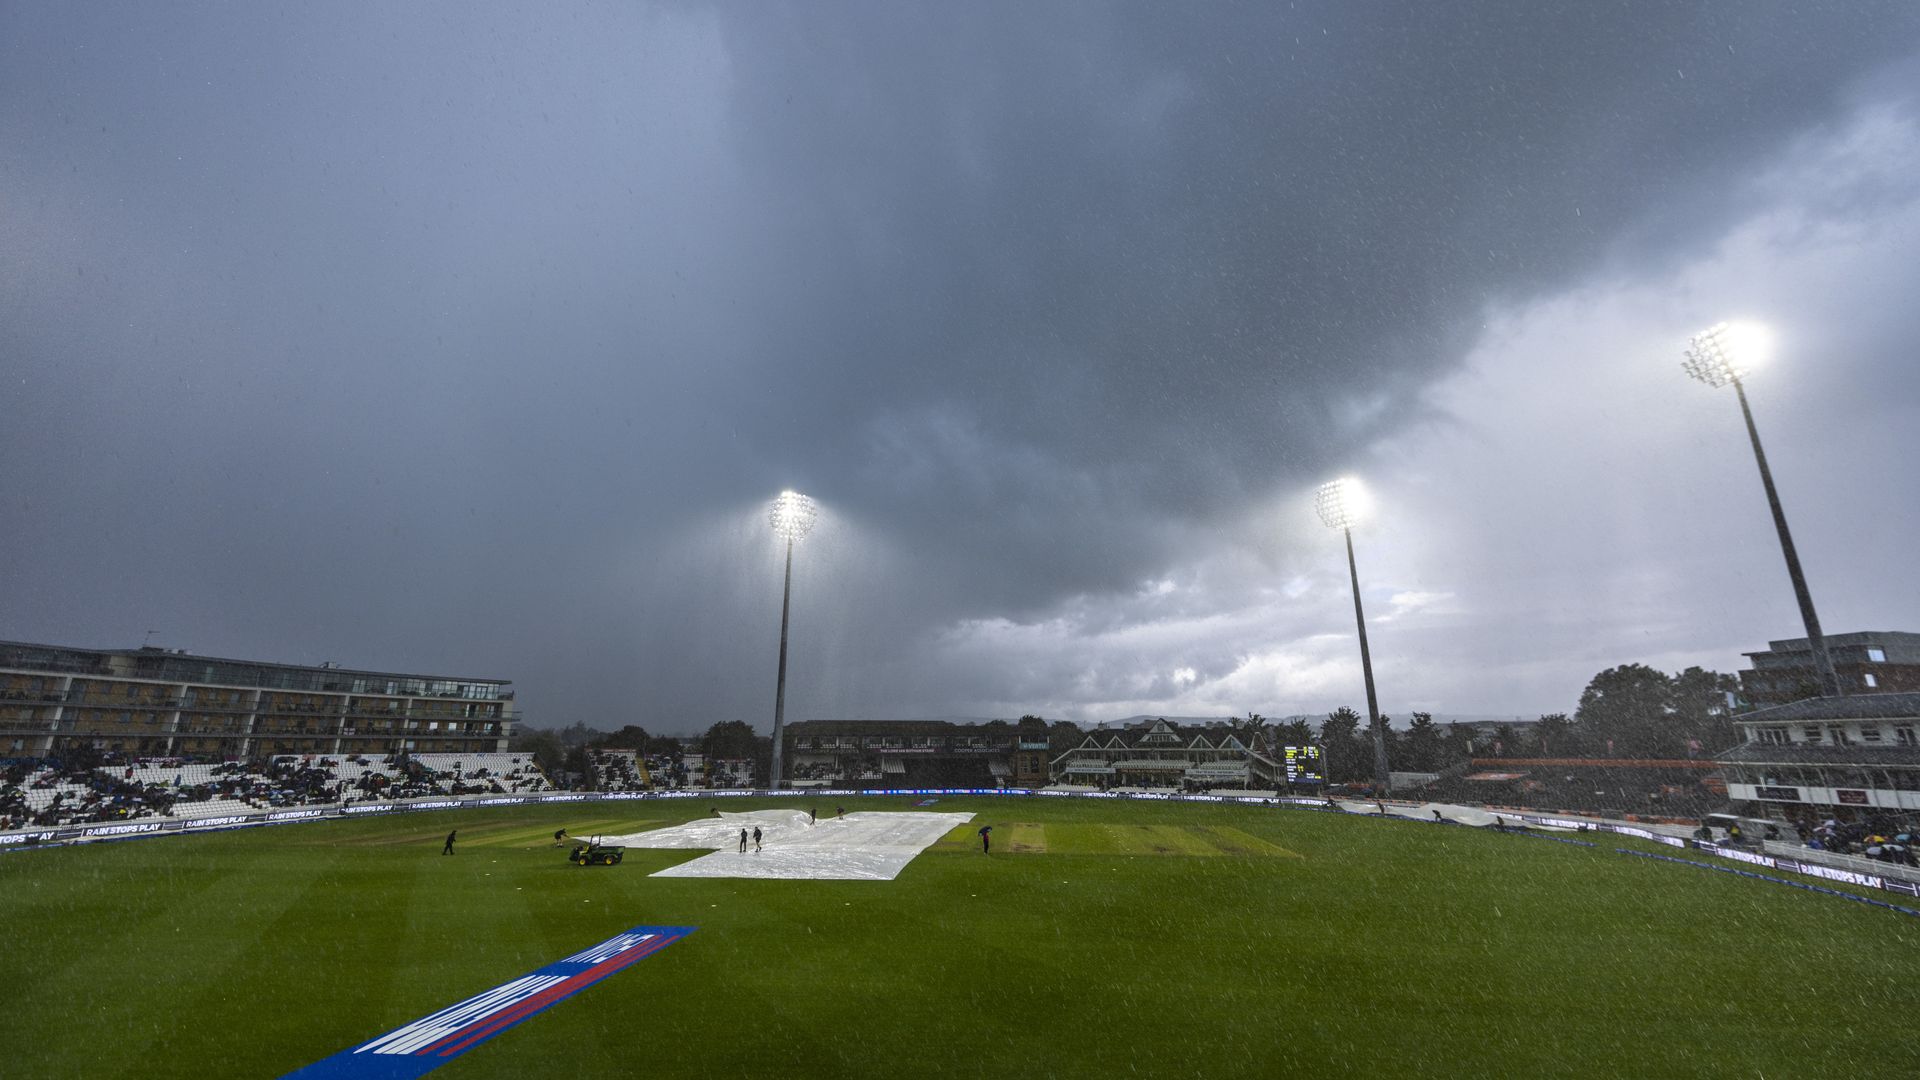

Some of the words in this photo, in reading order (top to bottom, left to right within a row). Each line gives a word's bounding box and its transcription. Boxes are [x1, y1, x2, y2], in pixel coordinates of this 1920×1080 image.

[205, 818, 228, 826] STOPS
[86, 828, 108, 836] RAIN
[110, 826, 138, 834] STOPS
[139, 824, 160, 832] PLAY
[0, 835, 26, 844] TOPS
[1717, 848, 1735, 860] RAIN
[1735, 851, 1756, 864] STOPS
[1756, 855, 1775, 868] PLAY
[1800, 864, 1823, 877] RAIN
[1824, 868, 1855, 882] STOPS
[1855, 873, 1882, 888] PLAY
